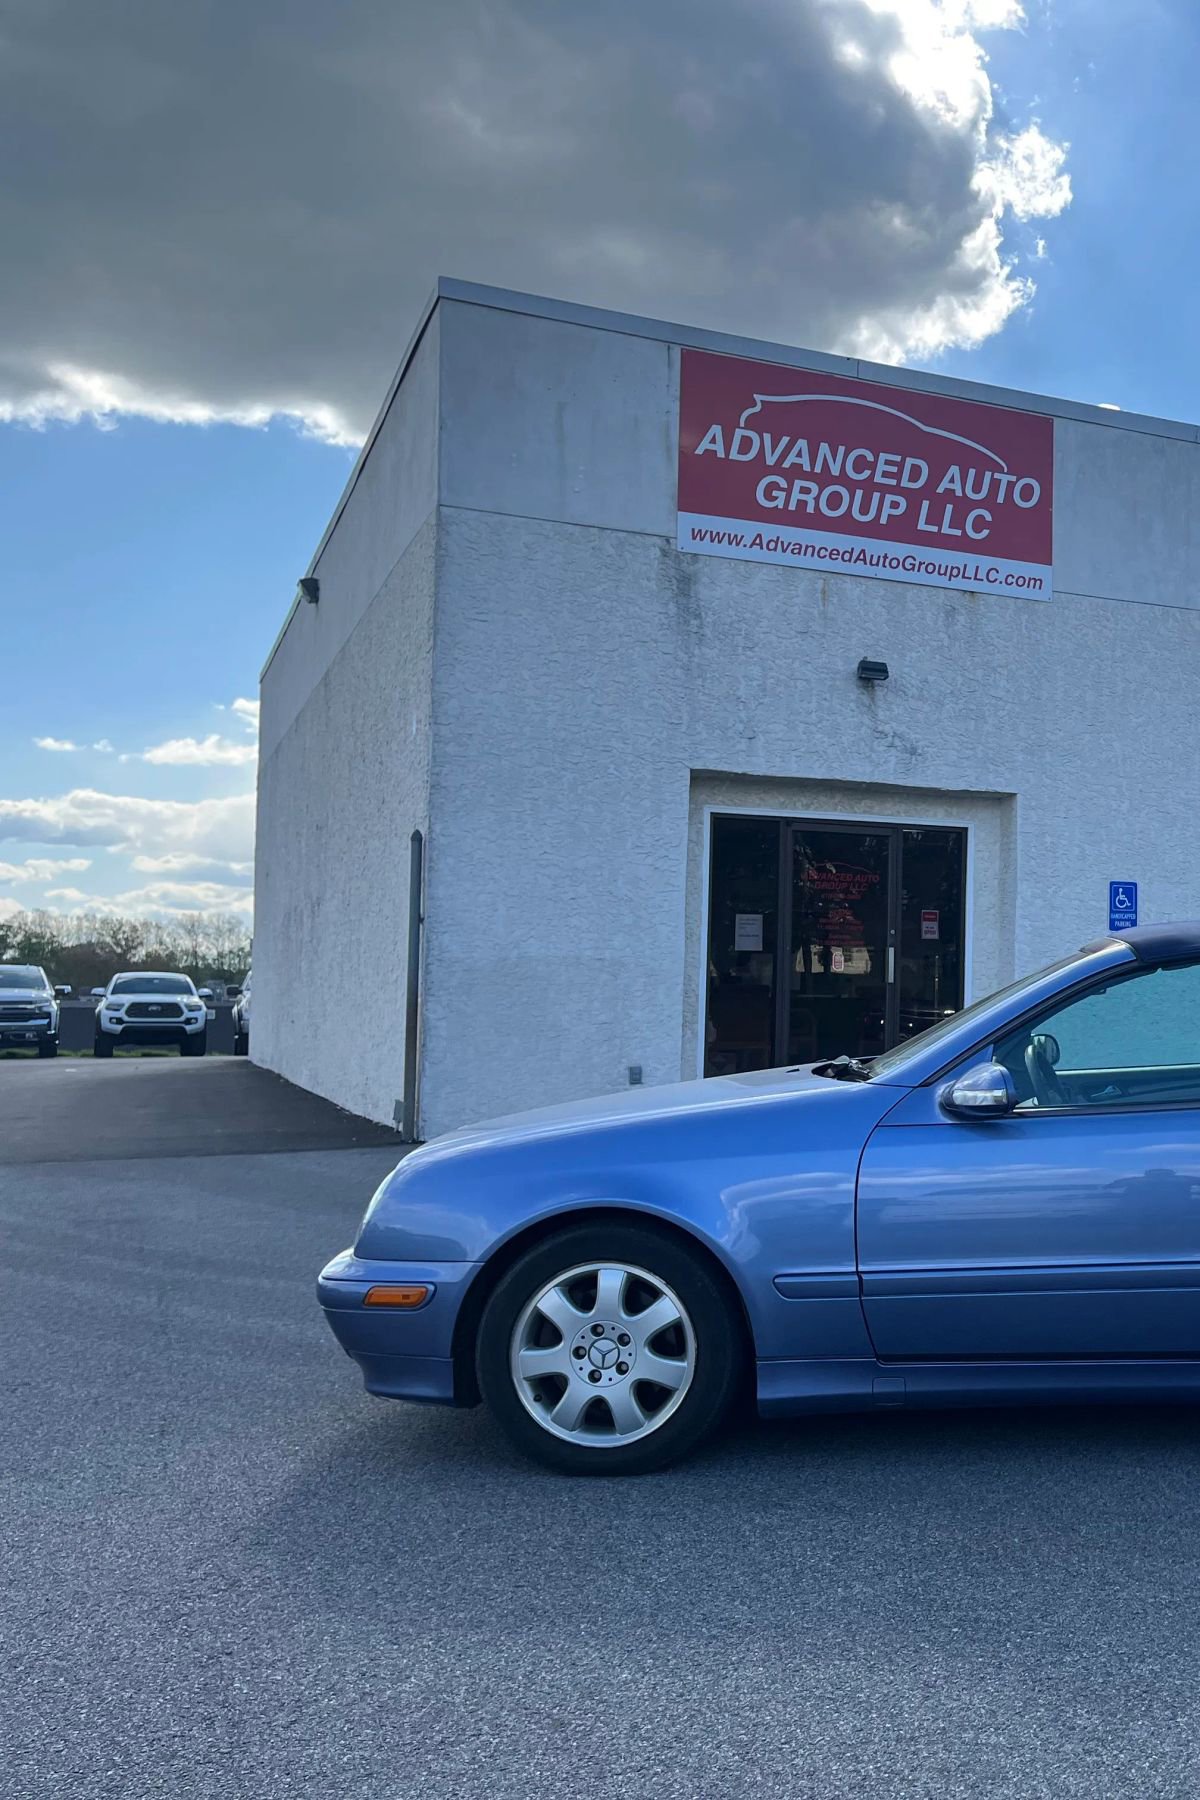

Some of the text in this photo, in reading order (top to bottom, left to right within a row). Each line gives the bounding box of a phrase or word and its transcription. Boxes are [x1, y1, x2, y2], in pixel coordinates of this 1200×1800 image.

[694, 424, 1041, 508] ADVANCED AUTO
[755, 474, 993, 540] GROUP LLC
[691, 527, 1044, 591] www.AdvancedAutoGroupLLC.com
